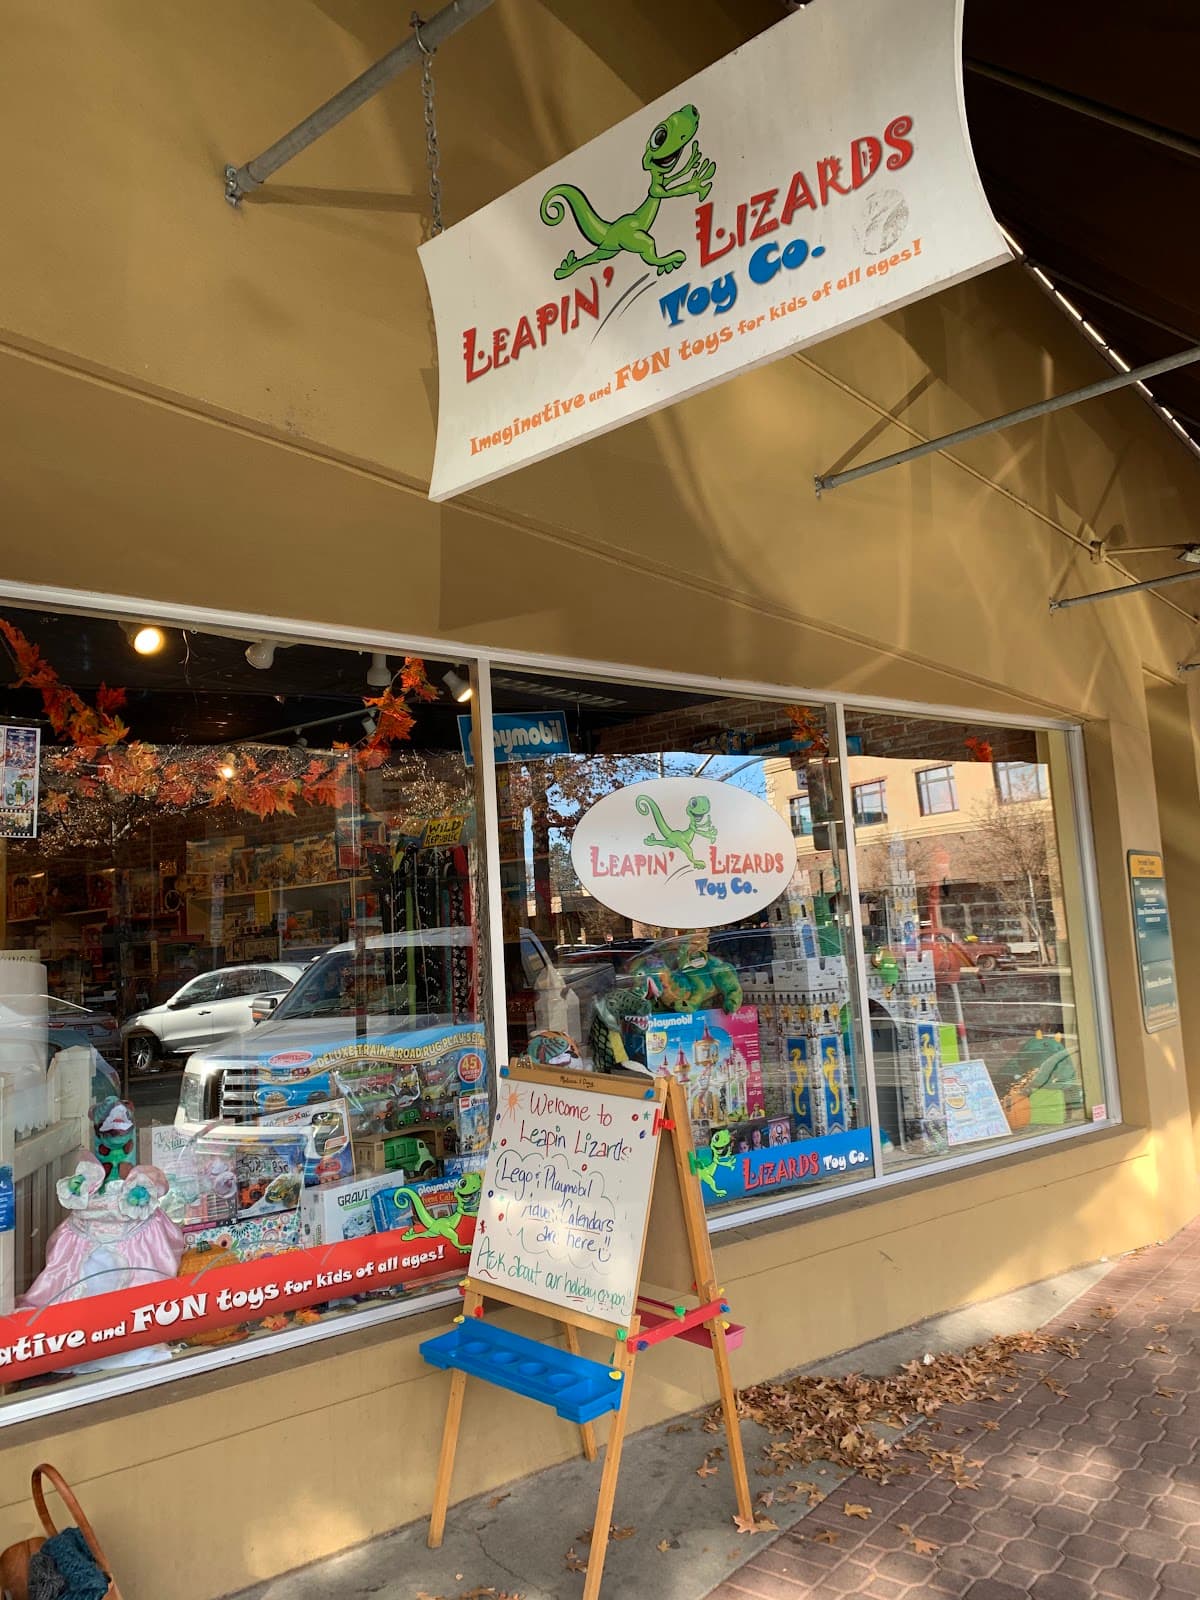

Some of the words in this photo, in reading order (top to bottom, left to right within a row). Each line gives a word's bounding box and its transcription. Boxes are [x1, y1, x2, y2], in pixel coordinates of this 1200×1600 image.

[462, 265, 614, 384] LEAPIN'
[695, 115, 913, 268] LIZARDS
[659, 270, 738, 328] Toy
[748, 238, 826, 285] Co.
[469, 393, 586, 456] Imaginative
[588, 382, 612, 403] and
[615, 347, 671, 391] FUN
[678, 326, 733, 361] toys
[737, 314, 765, 335] for
[769, 295, 808, 321] kids
[811, 281, 832, 301] of
[836, 267, 861, 290] all
[866, 238, 922, 276] ages!
[428, 821, 461, 835] WILD
[589, 845, 675, 877] LEAPIN'
[709, 845, 785, 875] LIZARDS
[694, 878, 727, 899] Toy
[730, 877, 758, 895] Co.
[647, 1014, 693, 1030] playmobil
[356, 1043, 388, 1058] TRAIN
[397, 1047, 423, 1060] ROAD
[423, 1041, 442, 1057] RUG
[442, 1034, 466, 1050] PLAY
[461, 1057, 477, 1070] 45
[530, 1090, 591, 1121] Welcome
[597, 1103, 613, 1127] to
[520, 1119, 566, 1157] Leapin
[417, 1178, 460, 1196] playmobi
[501, 1157, 534, 1201] Lego
[742, 1151, 820, 1191] LIZARDS
[823, 1154, 847, 1171] Toy
[848, 1149, 870, 1165] Co.
[476, 1236, 506, 1272] Ask
[507, 1255, 543, 1286] about
[563, 1271, 596, 1312] holiday
[91, 1321, 126, 1343] and
[130, 1293, 208, 1334] FUN
[216, 1284, 280, 1310] toys
[284, 1279, 313, 1295] for
[316, 1270, 353, 1289] kids
[355, 1262, 376, 1278] of
[377, 1255, 398, 1274] all
[401, 1244, 445, 1268] ages!
